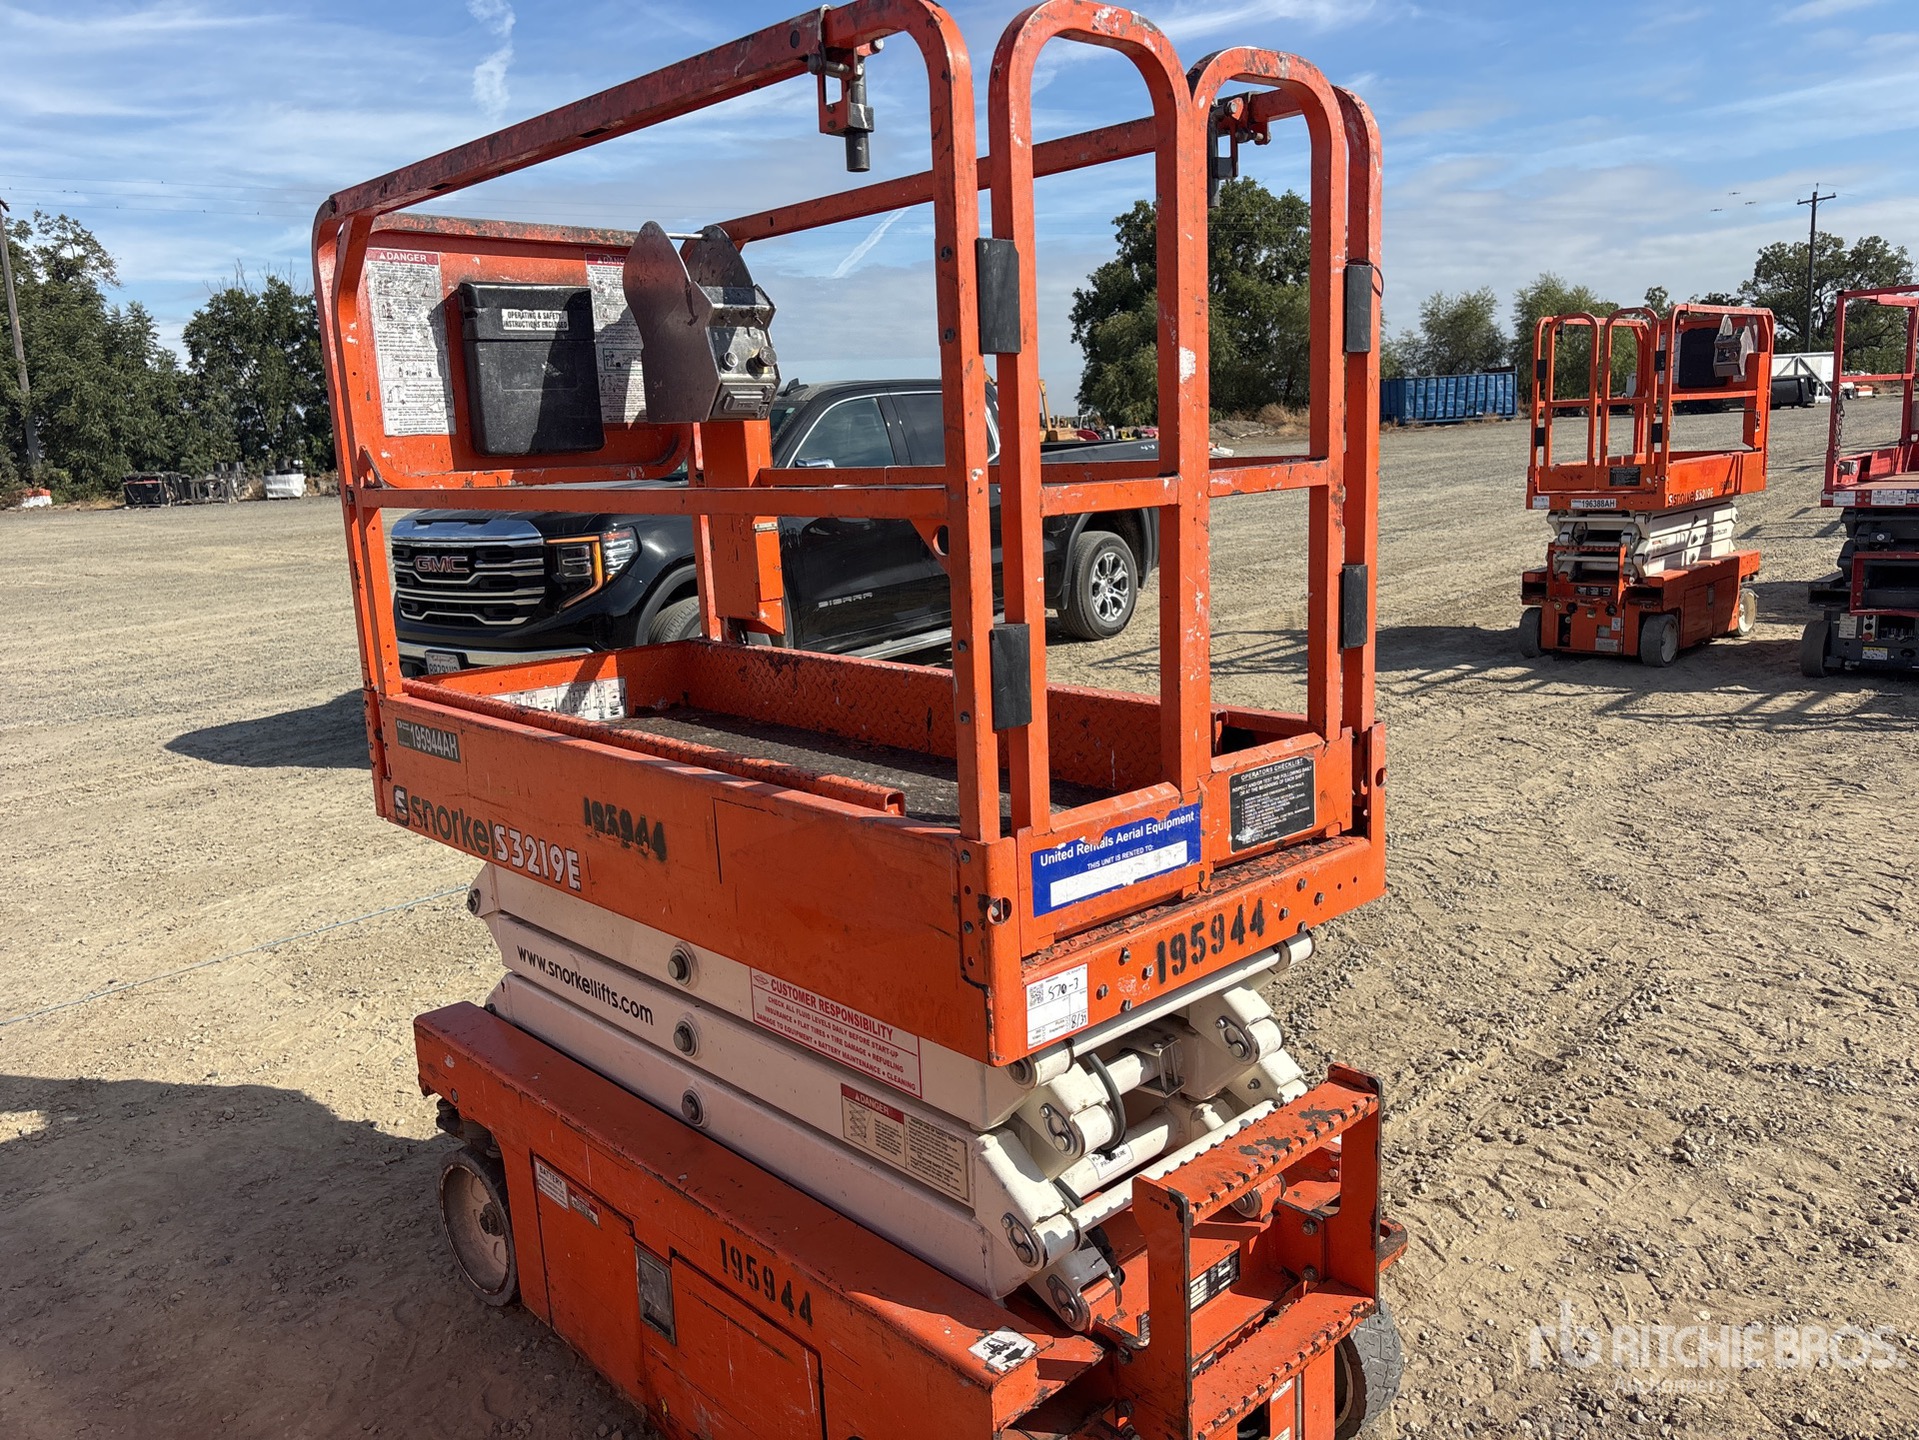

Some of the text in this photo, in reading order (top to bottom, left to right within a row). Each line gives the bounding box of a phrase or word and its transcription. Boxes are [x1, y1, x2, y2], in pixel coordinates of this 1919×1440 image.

[387, 252, 427, 262] DANGER
[604, 256, 625, 265] DANG
[508, 311, 536, 319] OPERATING
[542, 321, 568, 329] ENCLOSED
[1582, 500, 1615, 508] 196388AH
[415, 556, 470, 573] GMC
[818, 592, 873, 608] SIERRA
[410, 724, 458, 760] 195944AH
[1241, 758, 1304, 780] OPERATORS CHECKLIST
[410, 795, 498, 859] snorkel
[493, 823, 582, 892] S3219E
[1040, 844, 1074, 867] United
[1116, 826, 1144, 844] Aerial
[1146, 810, 1194, 836] Equipment
[1087, 860, 1100, 870] THIS
[1100, 856, 1115, 866] UNIT
[1115, 854, 1121, 862] IS
[1122, 847, 1144, 860] RENTED
[1156, 896, 1264, 984] 195944
[516, 944, 654, 1026] www.snorkellifts.com
[770, 979, 893, 1040] CUSTOMER RESPONSIBILITY
[764, 1005, 904, 1073] INSURANCE FLAT TIRES TIRE DAMAGE REFUELING
[768, 996, 899, 1058] CHECK ALL FLUID LEVELS DAILY BEFORE START-UP
[756, 1012, 916, 1091] DAMAGE TO EQUIPMENT BATTERY MAINTENANCE CLEANING
[860, 1094, 890, 1116] DANGER
[720, 1238, 814, 1332] 195944
